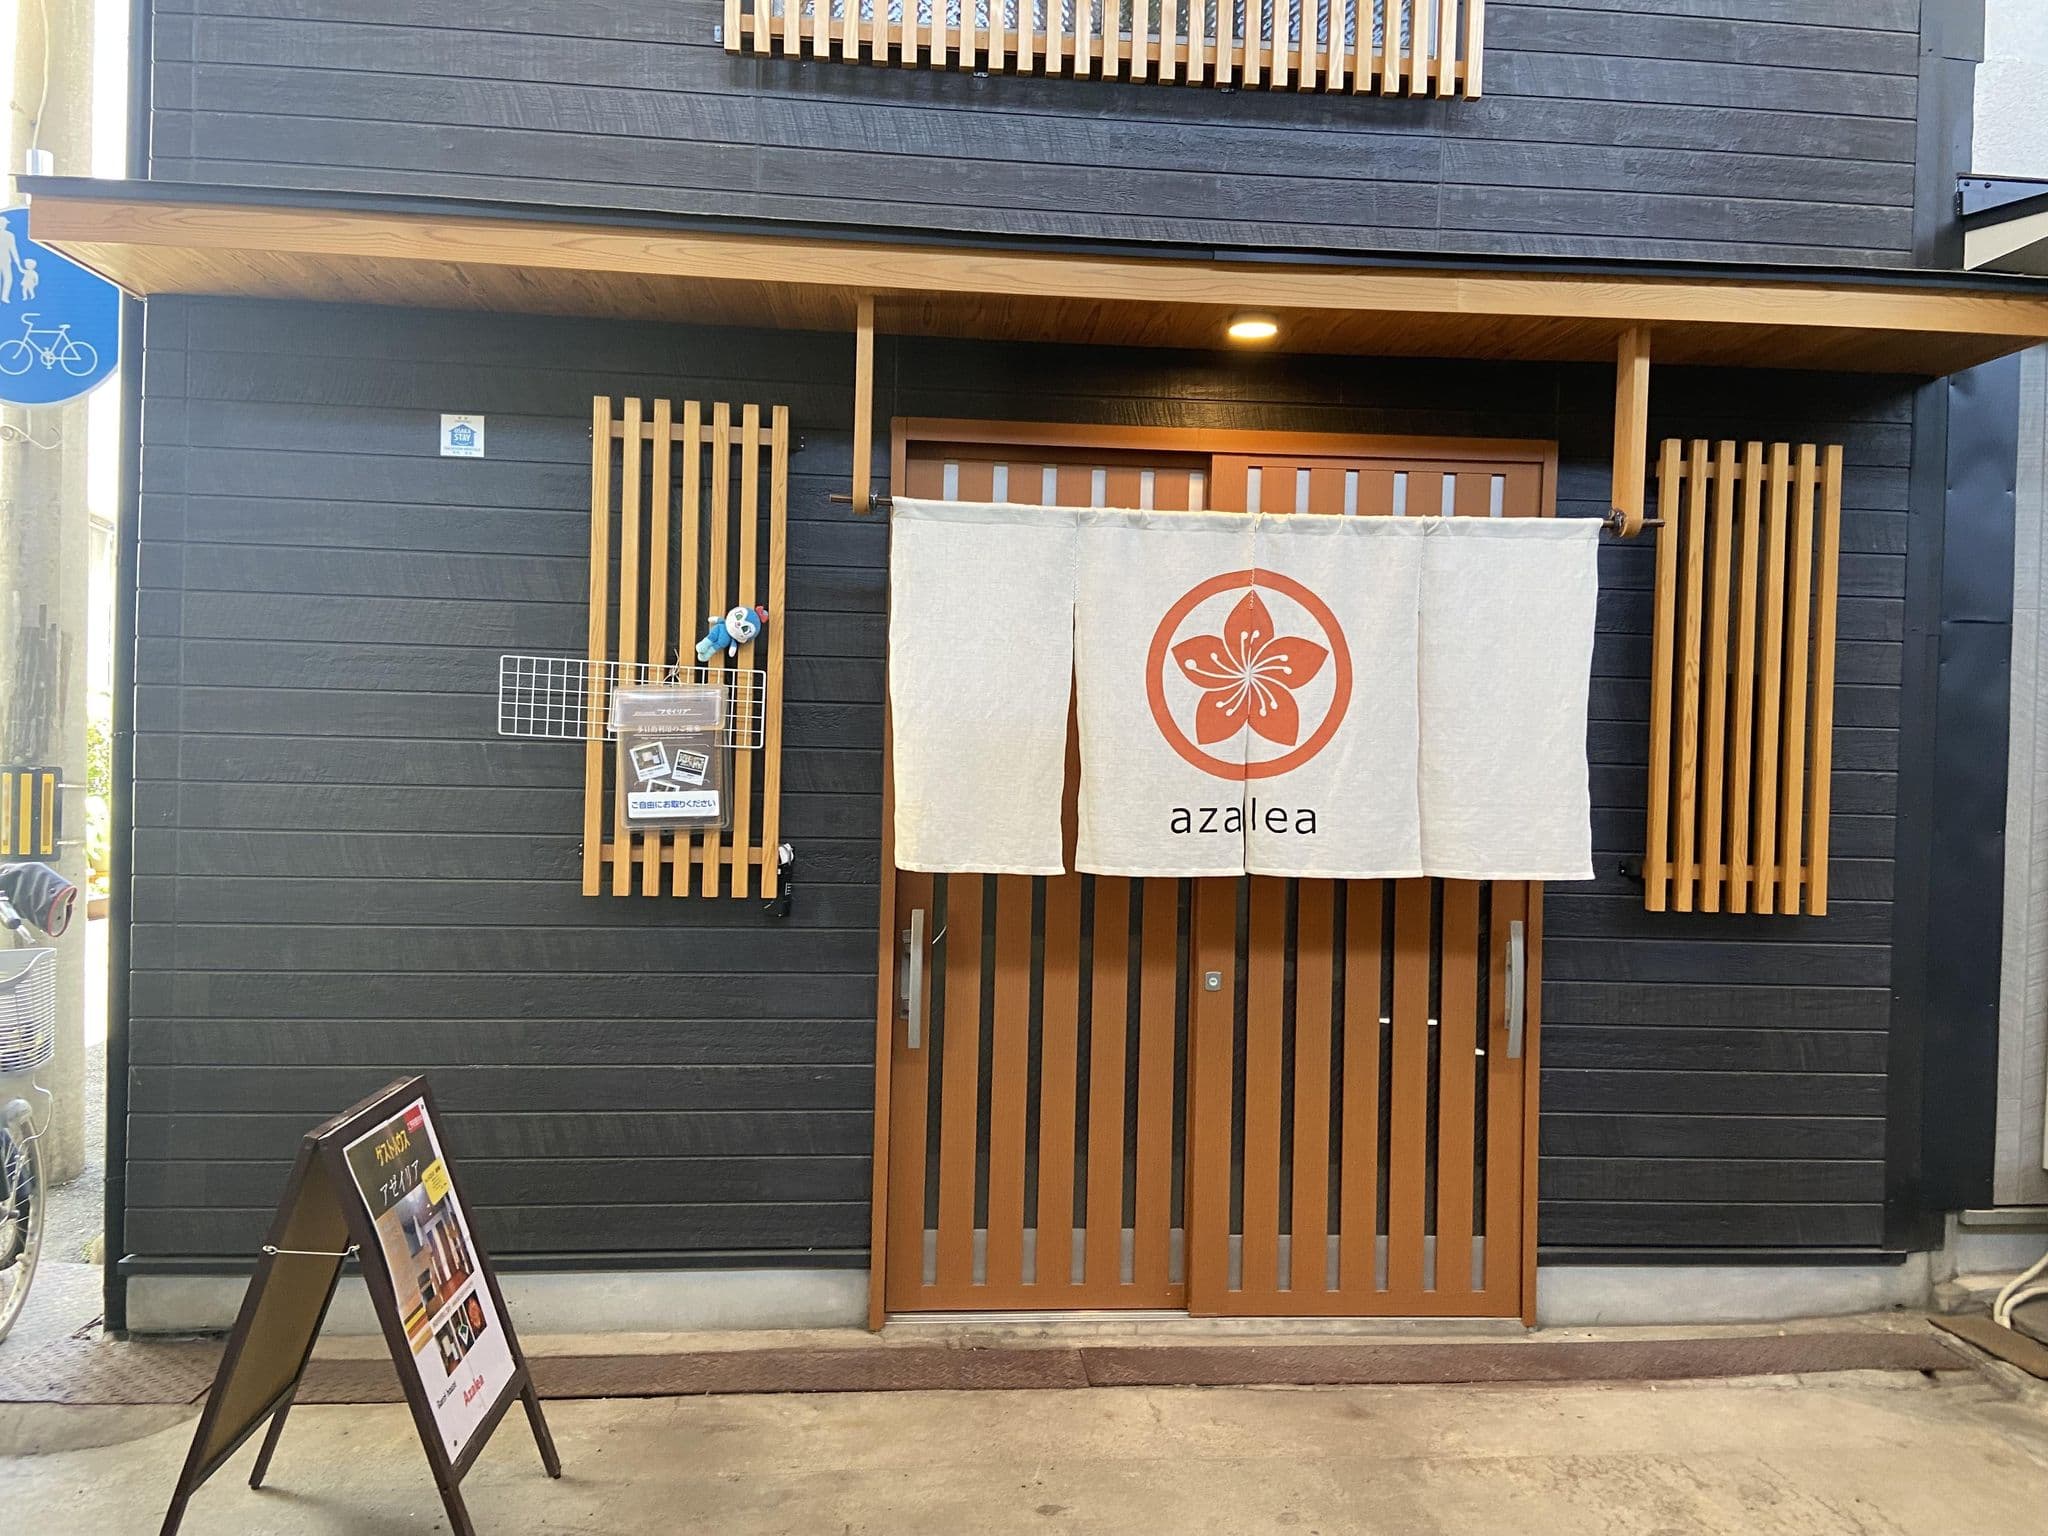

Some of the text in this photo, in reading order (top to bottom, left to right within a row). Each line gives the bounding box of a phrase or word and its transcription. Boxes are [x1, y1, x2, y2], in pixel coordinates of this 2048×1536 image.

[454, 433, 471, 442] STAY
[631, 800, 716, 809] ご自由にお取りください
[1170, 797, 1317, 835] azalea
[379, 1159, 419, 1206] アゼイリア
